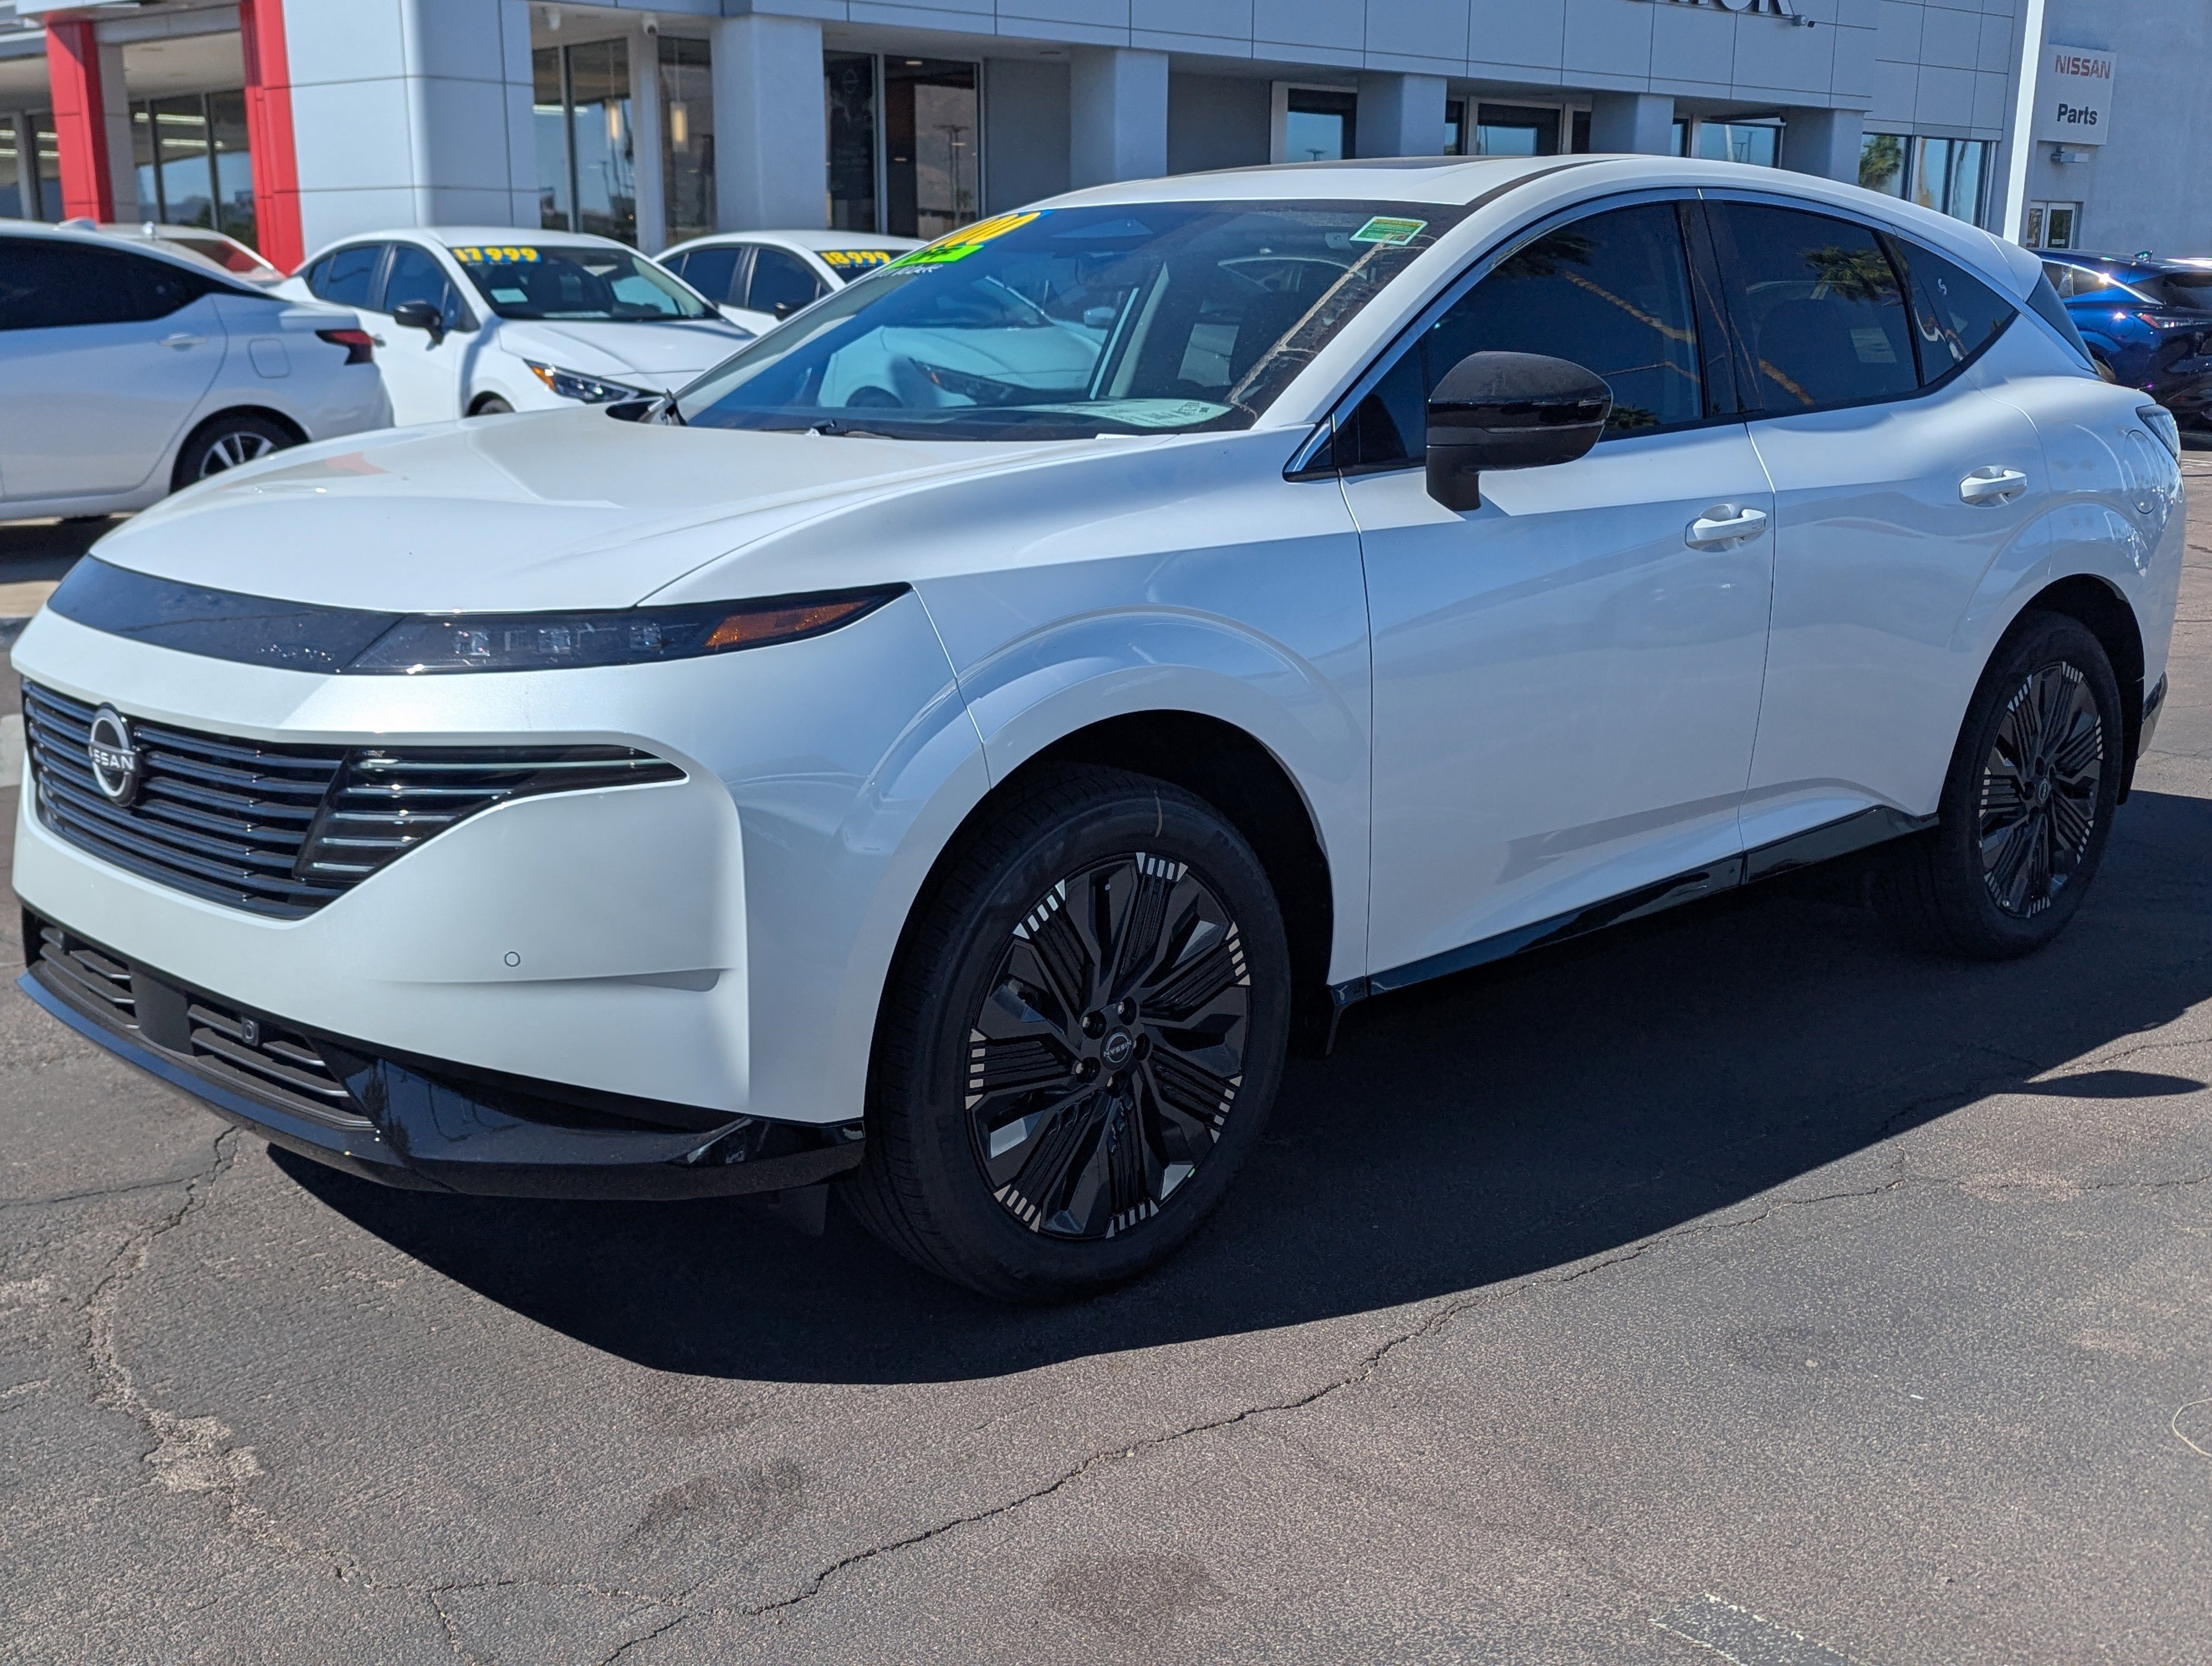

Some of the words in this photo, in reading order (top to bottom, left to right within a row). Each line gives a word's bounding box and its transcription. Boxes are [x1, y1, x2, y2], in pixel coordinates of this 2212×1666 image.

[2055, 55, 2111, 79] NISSAN
[2057, 103, 2098, 125] Parts
[88, 745, 134, 770] ISSAN
